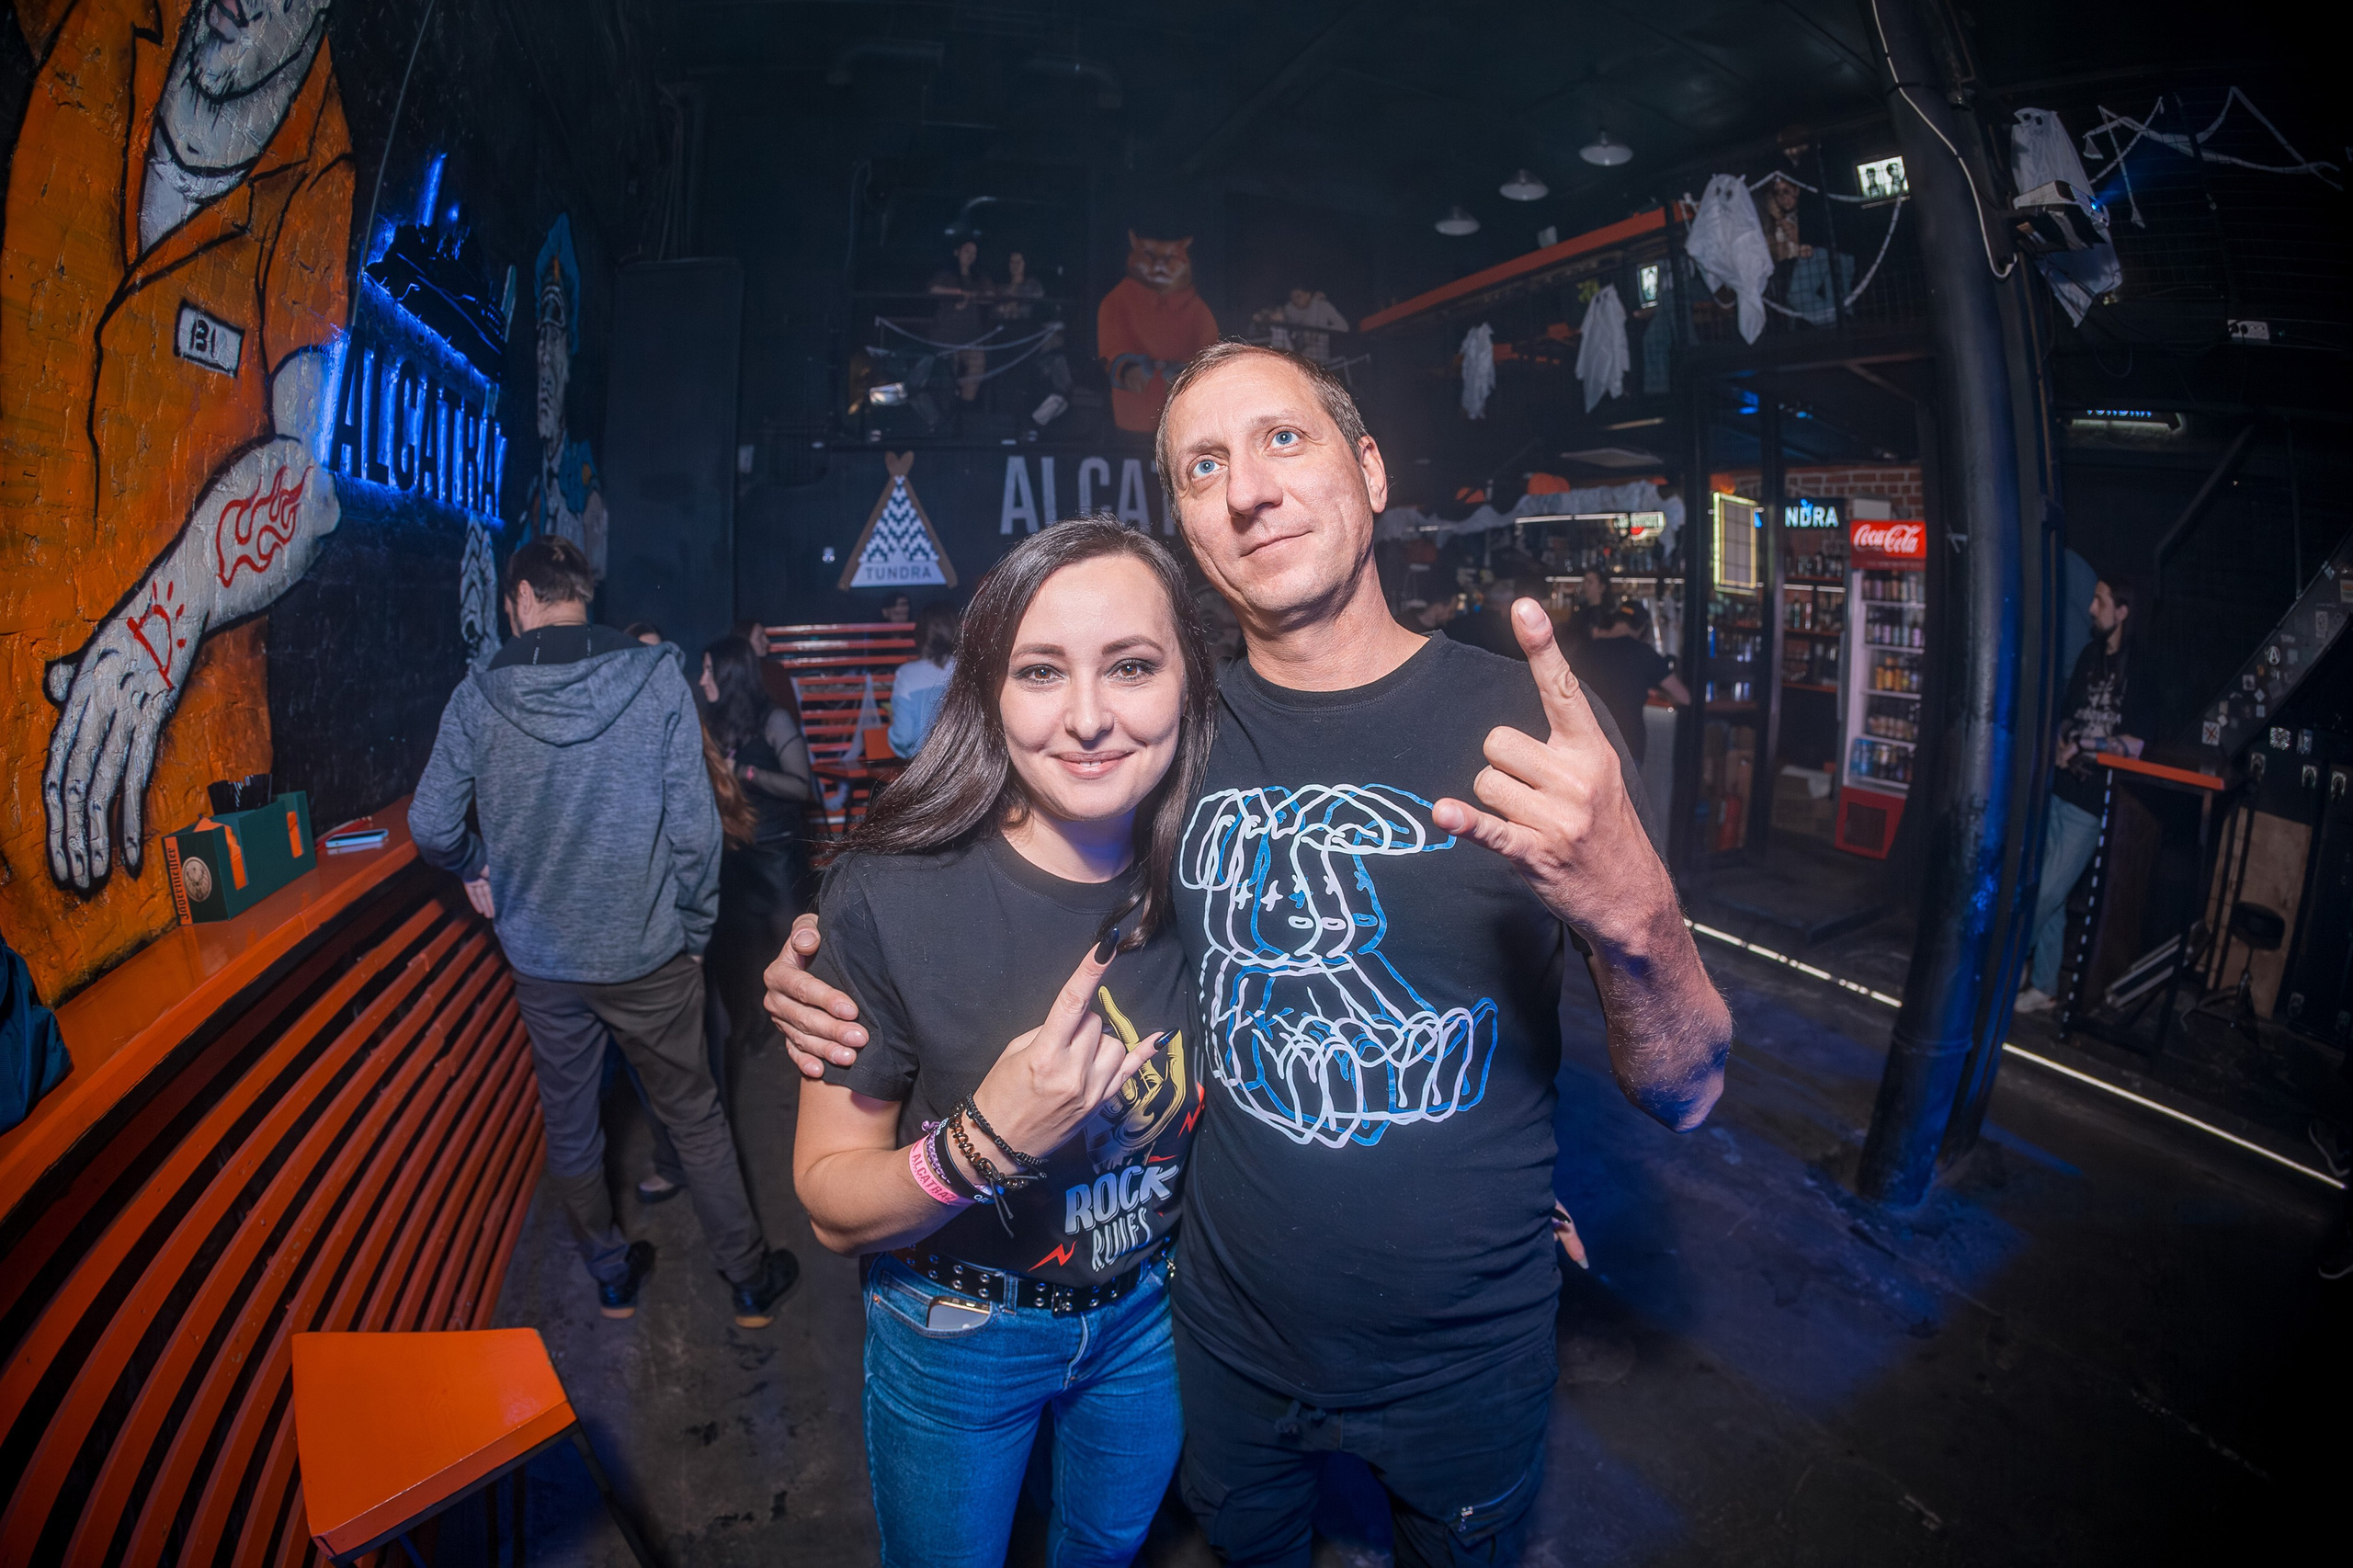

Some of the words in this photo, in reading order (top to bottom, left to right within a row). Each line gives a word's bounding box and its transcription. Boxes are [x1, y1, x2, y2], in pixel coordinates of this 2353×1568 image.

[1853, 524, 1922, 552] Coca-Cola
[865, 564, 932, 581] TUNDRA
[911, 1153, 959, 1204] ALCATRAZ
[1064, 1164, 1179, 1235] ROCK
